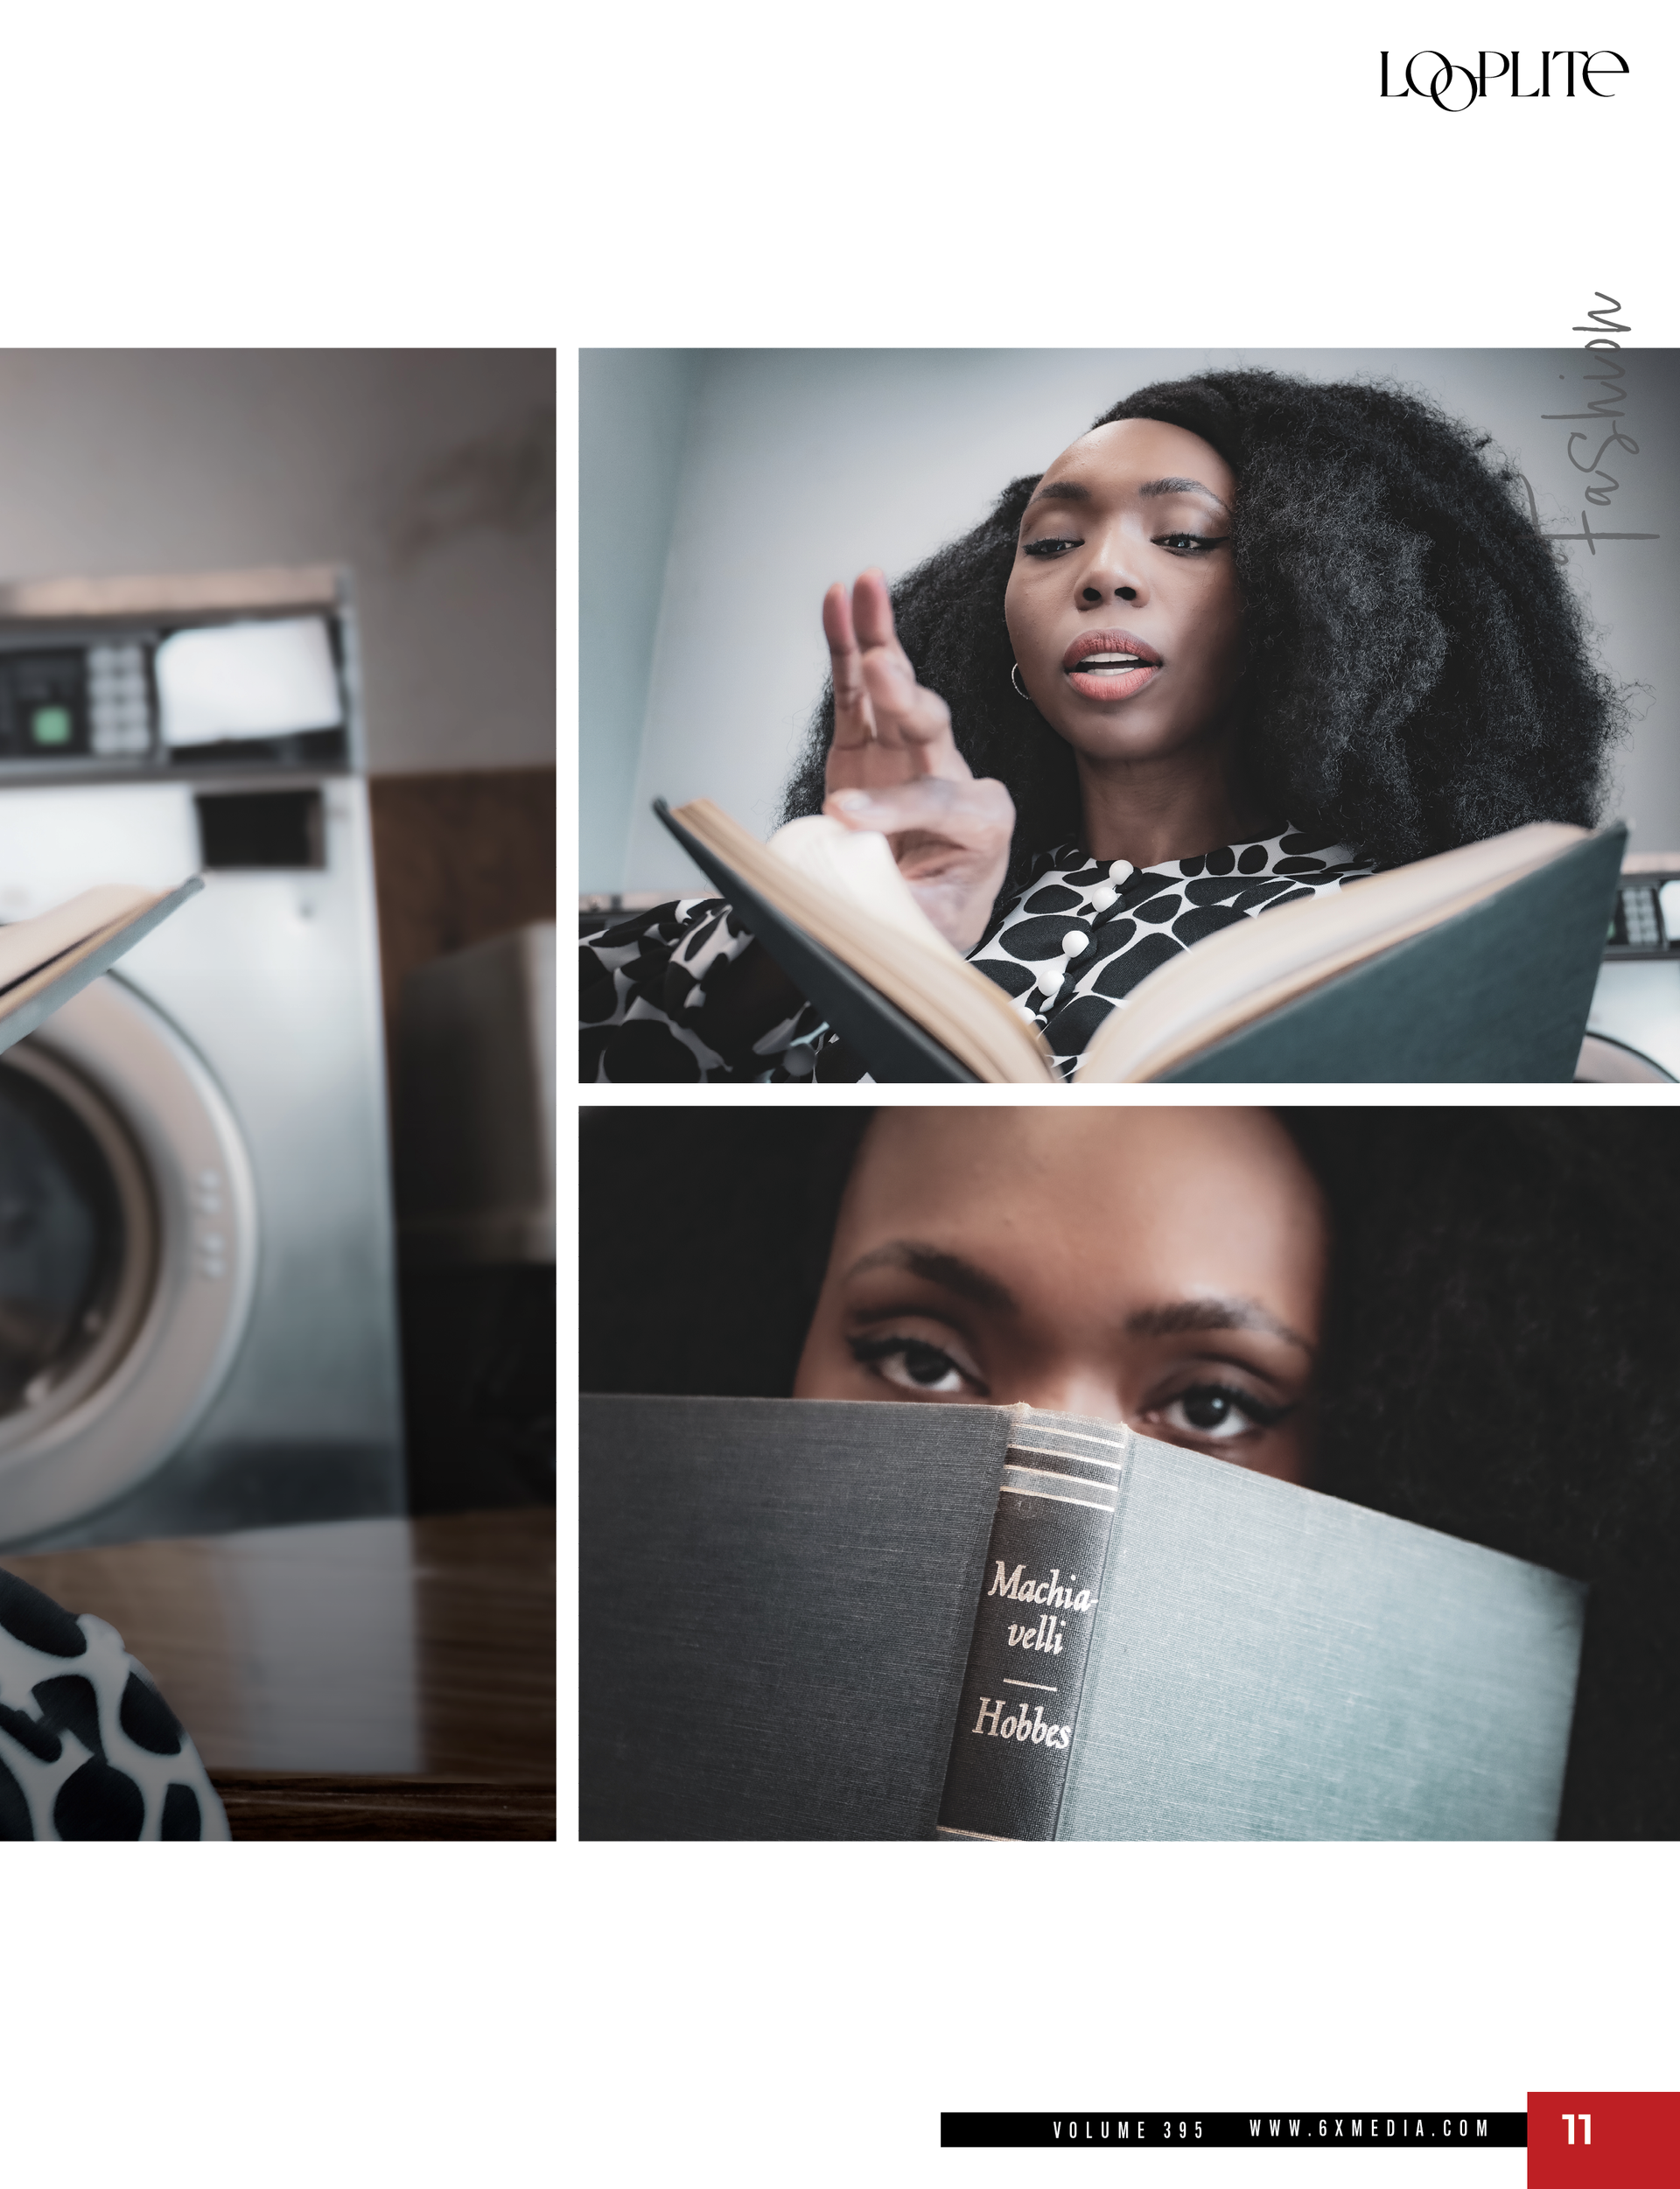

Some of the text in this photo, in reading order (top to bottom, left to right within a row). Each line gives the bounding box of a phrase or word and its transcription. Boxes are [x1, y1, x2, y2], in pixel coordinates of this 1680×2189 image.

[988, 1560, 1099, 1612] Machia-
[1007, 1615, 1067, 1656] velli
[972, 1696, 1073, 1751] Hobbes
